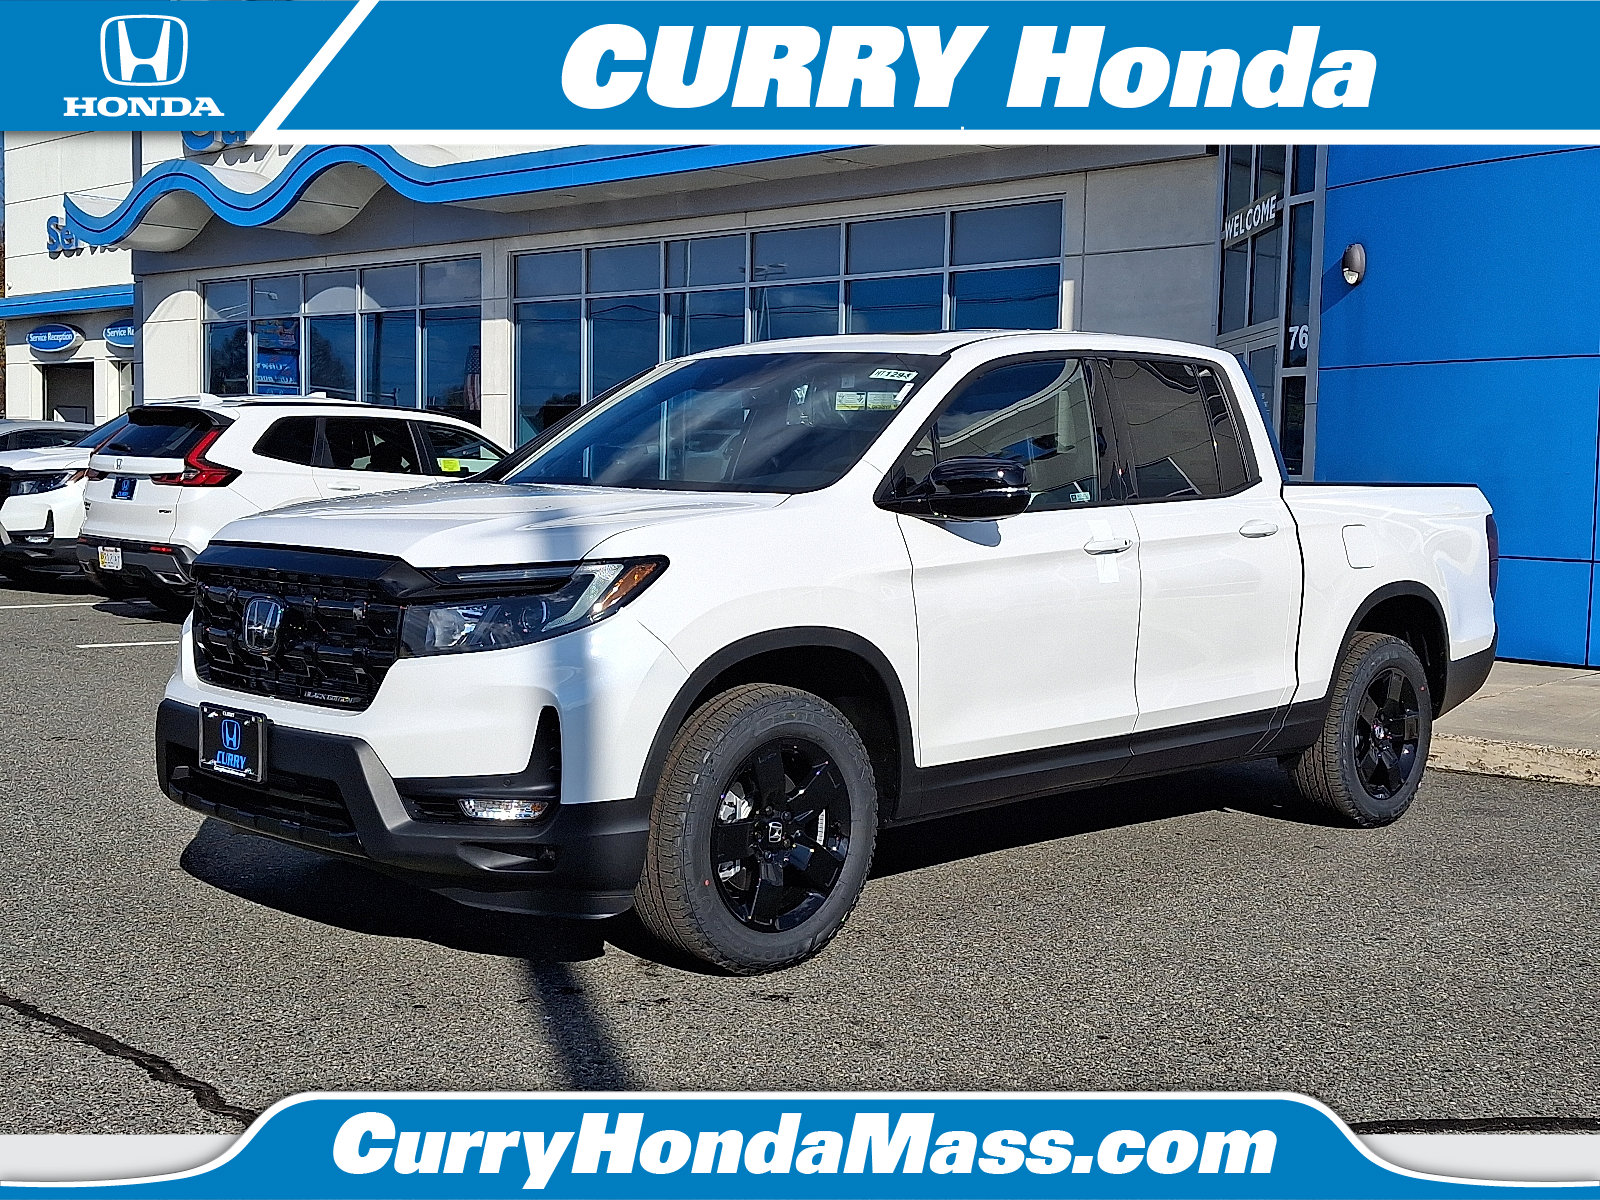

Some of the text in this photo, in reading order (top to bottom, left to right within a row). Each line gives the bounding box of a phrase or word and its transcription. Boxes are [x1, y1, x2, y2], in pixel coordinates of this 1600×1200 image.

[1225, 195, 1276, 241] WELCOME
[29, 331, 73, 343] Service Reception
[107, 328, 126, 336] Service
[1289, 325, 1309, 350] 76
[217, 750, 247, 770] CURRY
